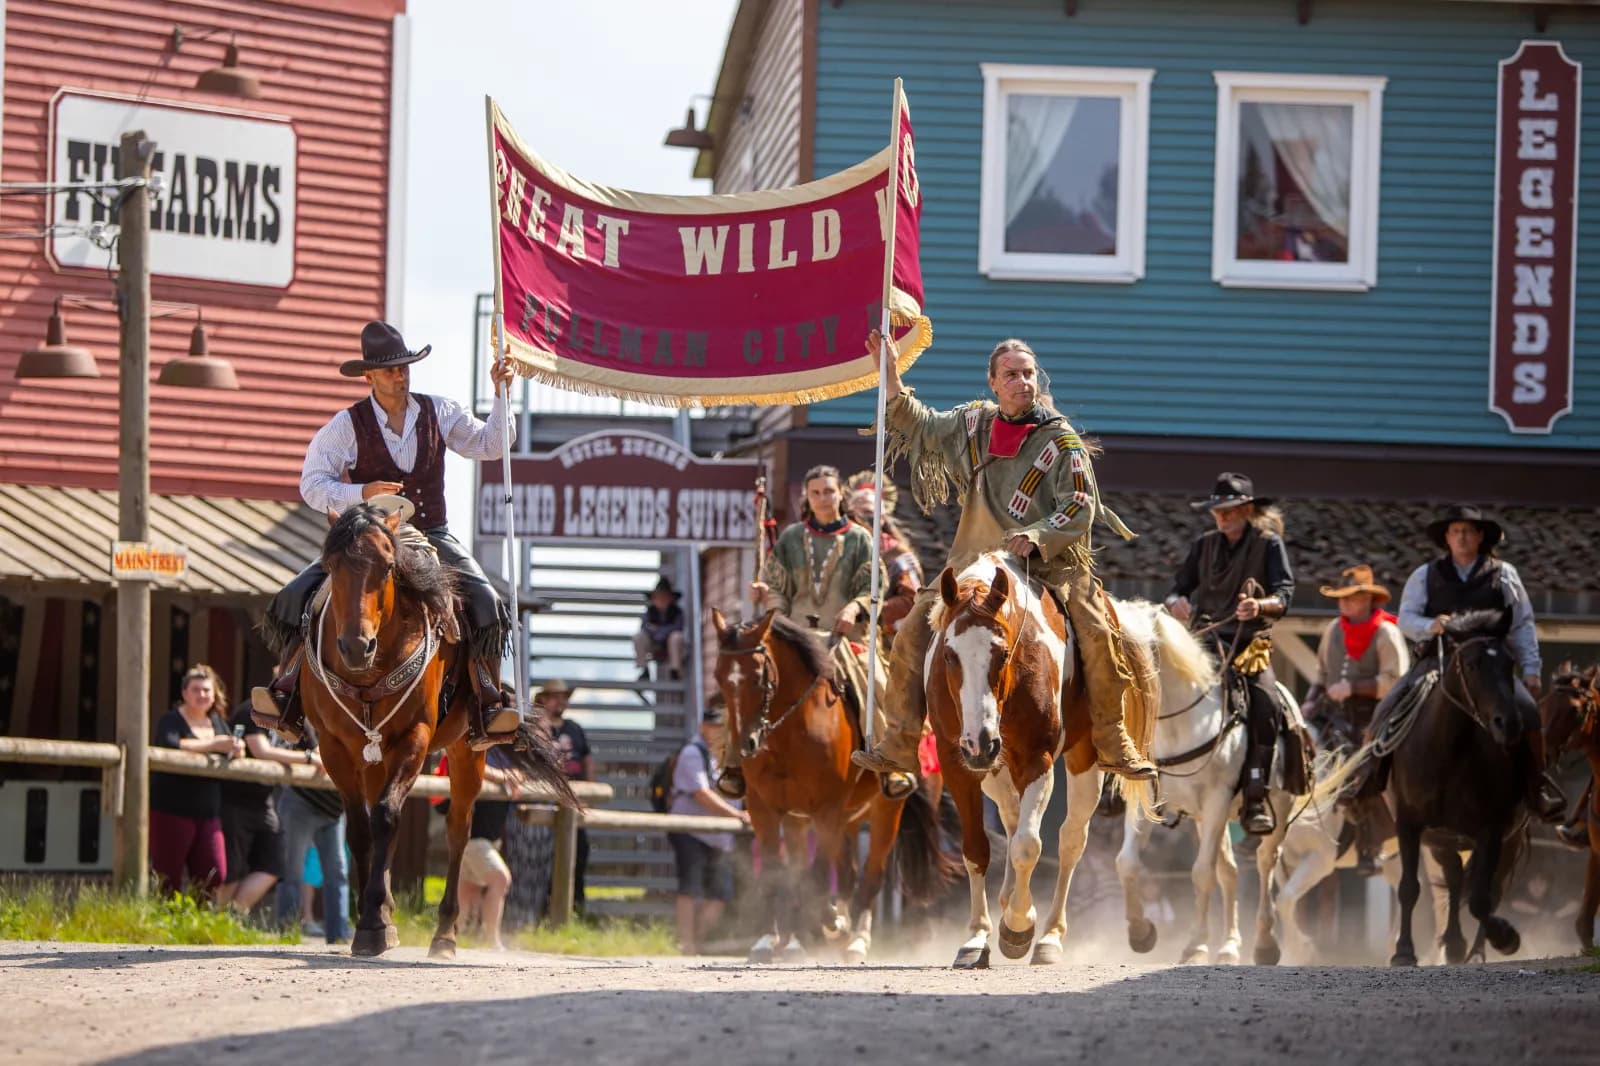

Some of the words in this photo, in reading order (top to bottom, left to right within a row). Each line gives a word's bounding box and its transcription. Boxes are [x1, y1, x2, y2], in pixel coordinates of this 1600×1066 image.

[65, 140, 281, 245] FIEARMS
[678, 208, 842, 276] WILD
[1511, 69, 1559, 404] LEGENDS
[520, 292, 710, 367] PULLMAN
[743, 316, 840, 366] CITY
[563, 485, 670, 537] LEGENDS
[676, 488, 757, 539] SUITES
